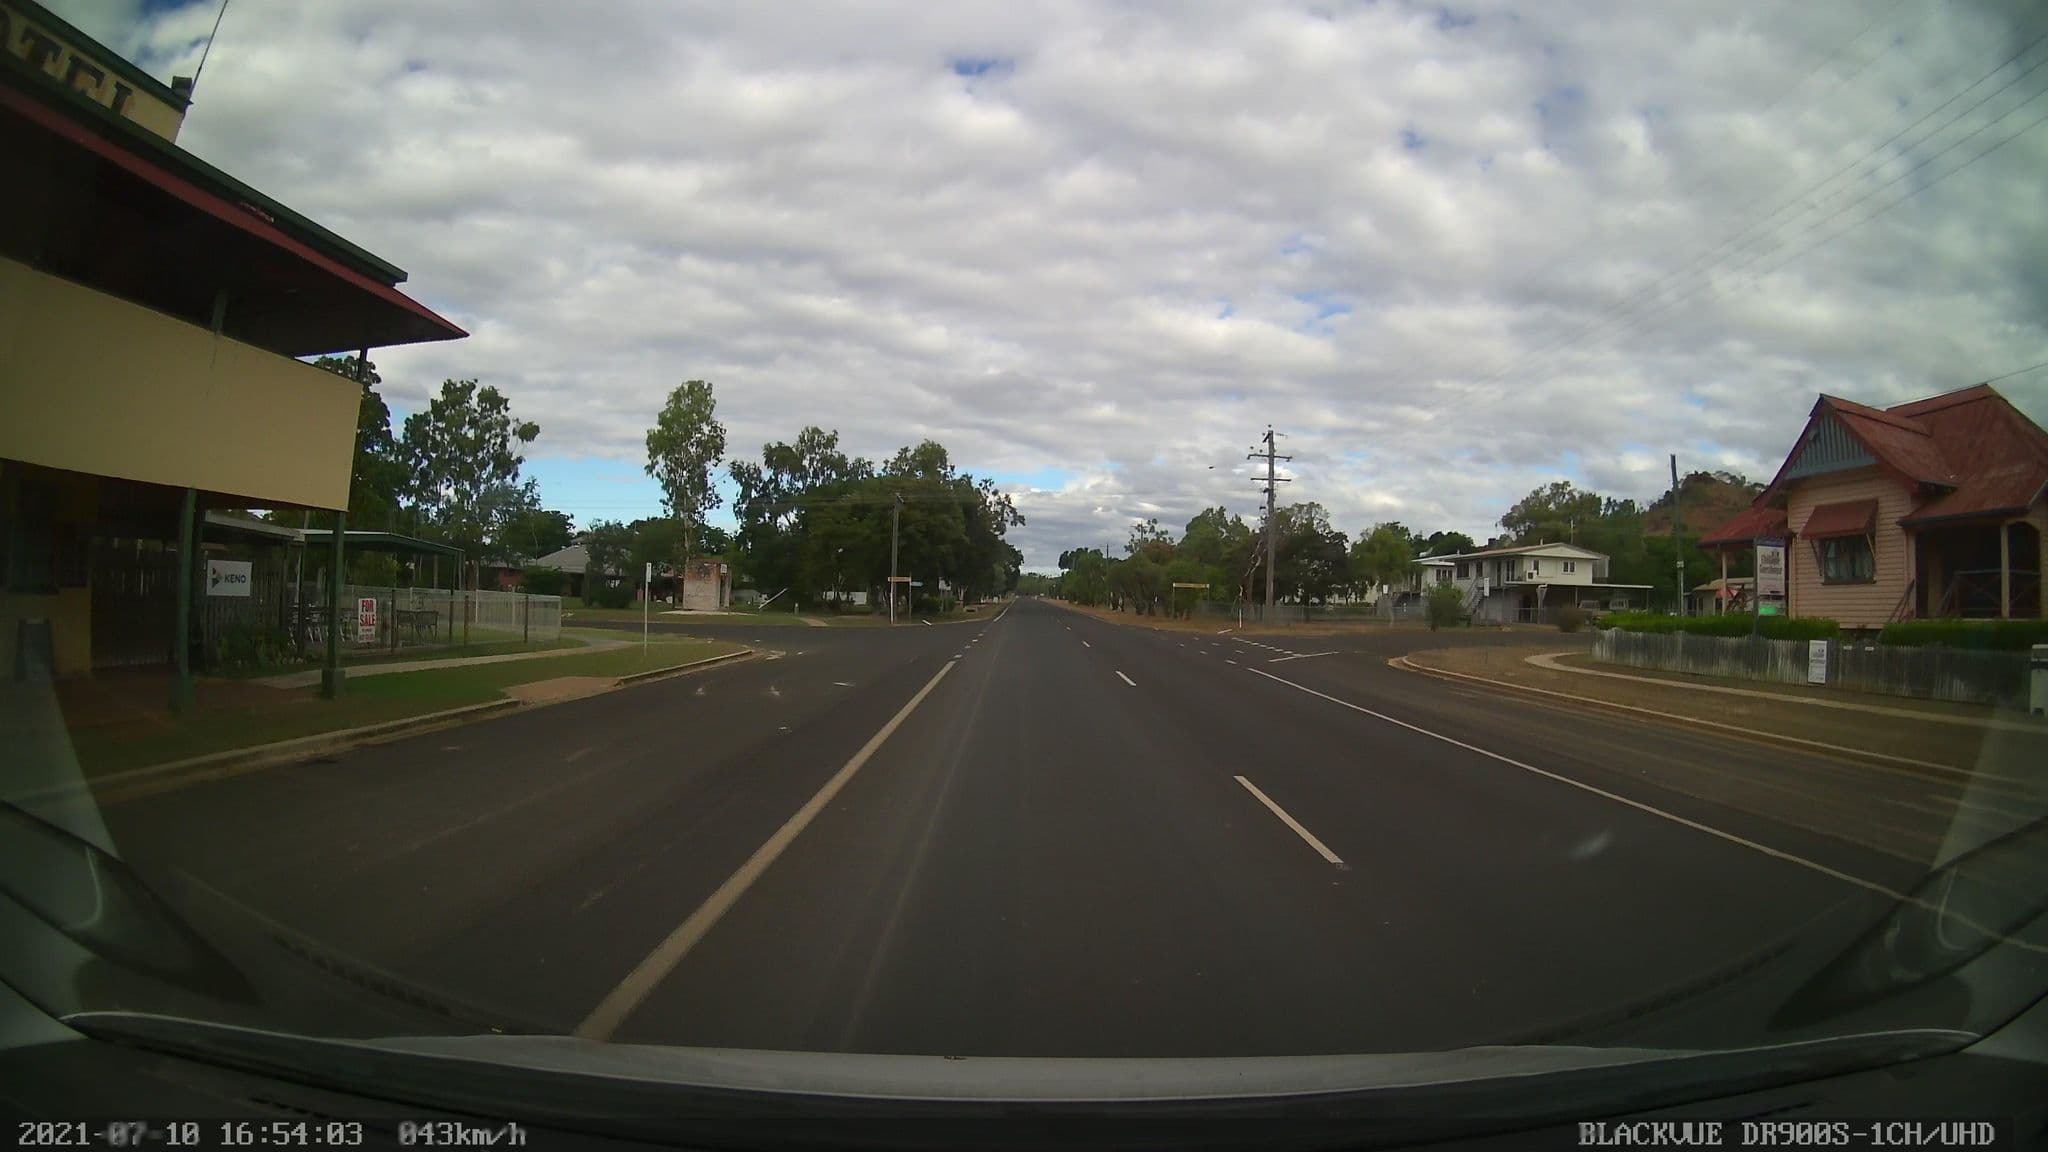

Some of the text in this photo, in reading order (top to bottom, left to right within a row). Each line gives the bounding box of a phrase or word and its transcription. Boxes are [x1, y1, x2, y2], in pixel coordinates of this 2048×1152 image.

[224, 574, 247, 584] KENO
[361, 599, 374, 613] FOR
[360, 613, 376, 627] SALE
